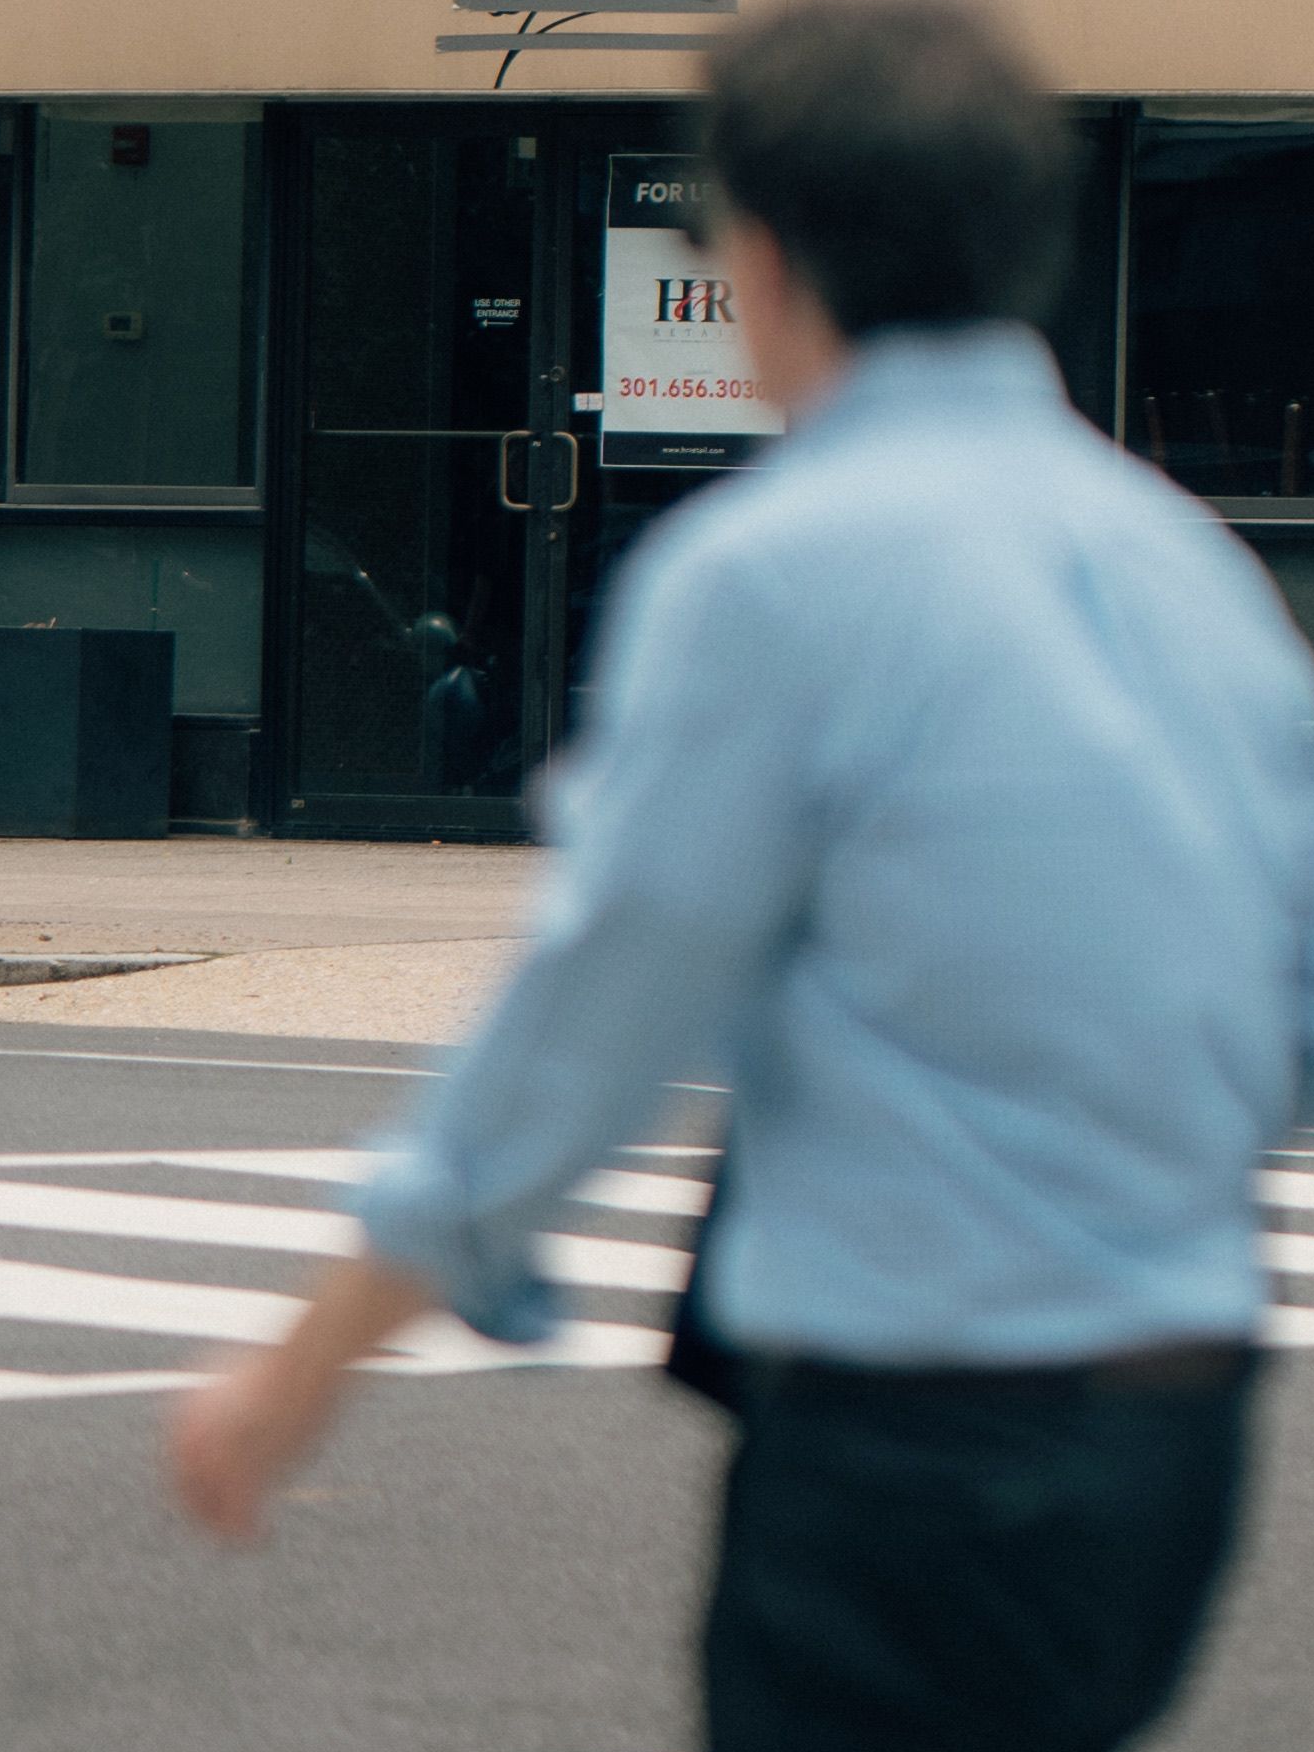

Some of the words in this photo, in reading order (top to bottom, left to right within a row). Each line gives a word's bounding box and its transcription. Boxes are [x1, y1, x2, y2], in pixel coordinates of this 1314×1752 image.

[636, 182, 685, 203] FOR
[475, 298, 491, 307] USE
[494, 298, 521, 307] OTHER
[476, 309, 519, 317] ENTRANCE
